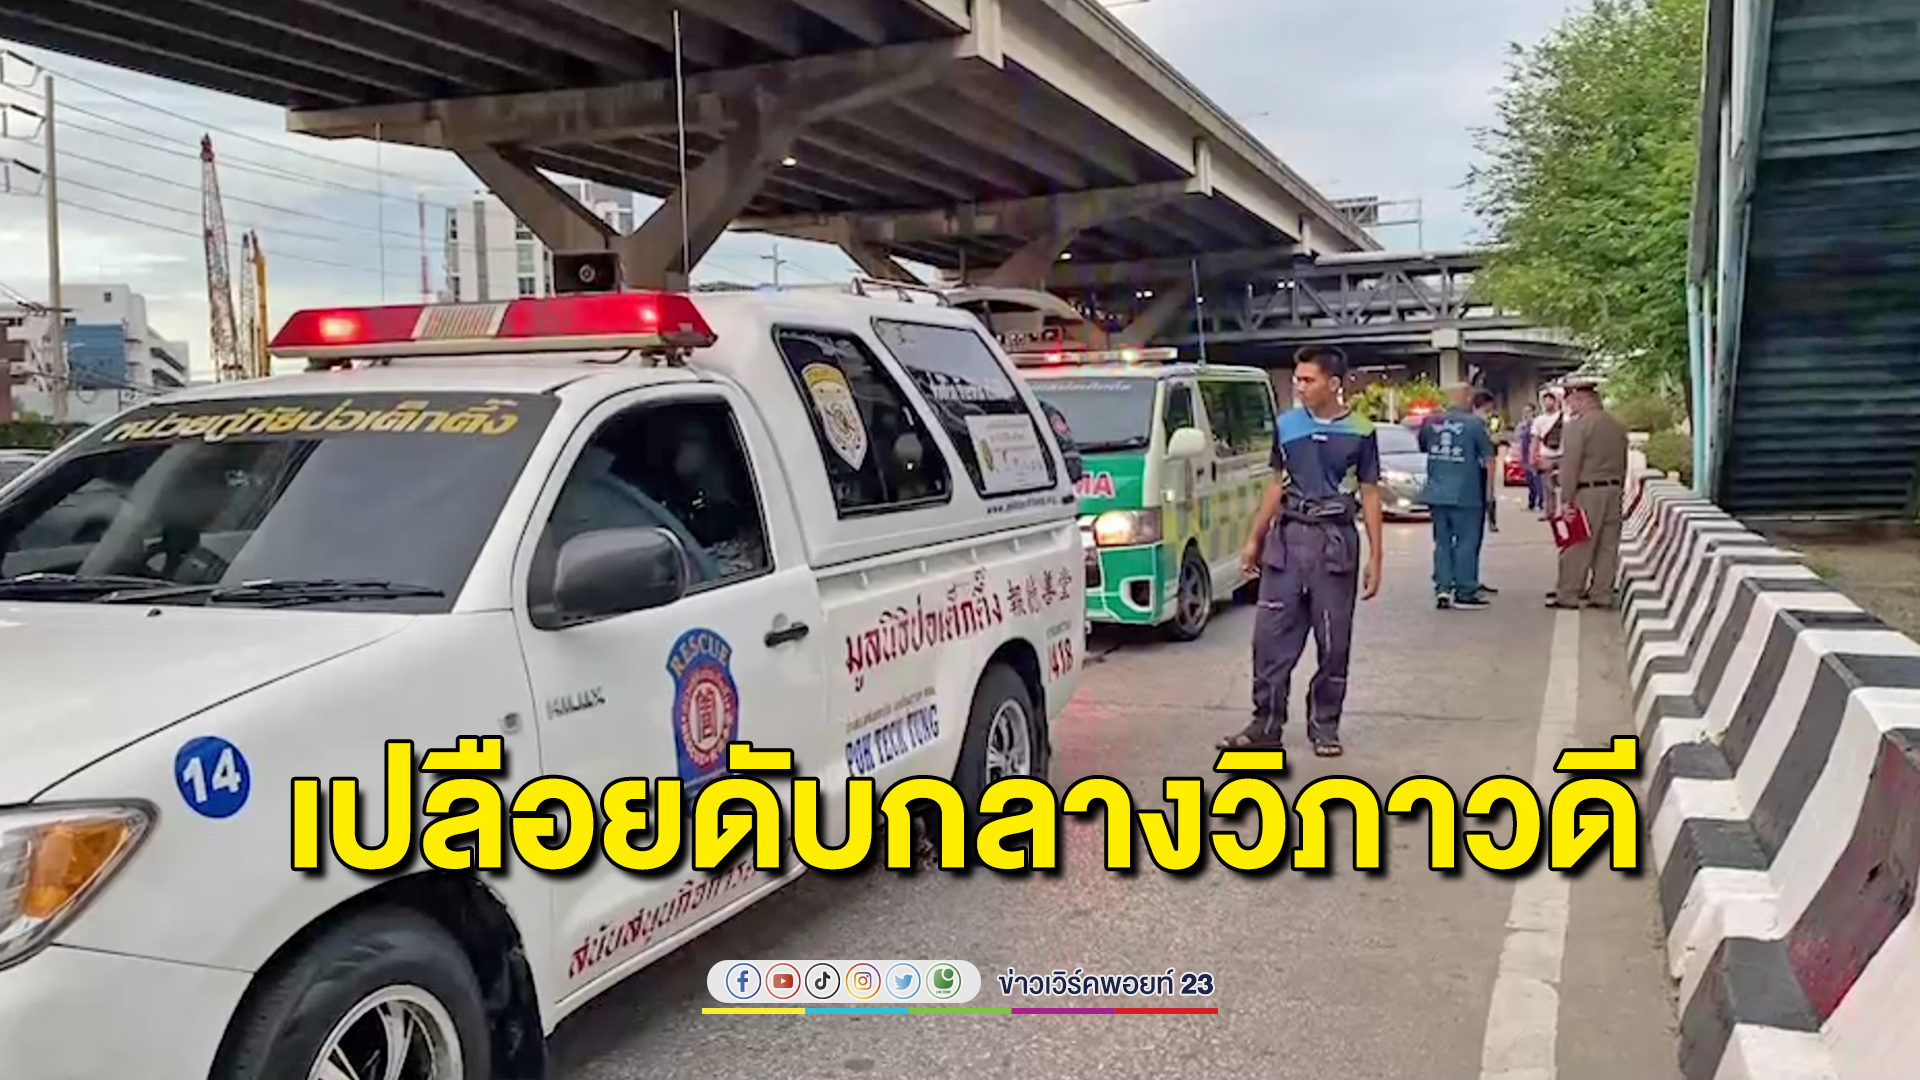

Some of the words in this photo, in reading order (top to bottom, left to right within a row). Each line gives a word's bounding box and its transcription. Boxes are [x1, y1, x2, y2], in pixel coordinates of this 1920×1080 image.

[670, 633, 732, 677] RESCUE
[846, 732, 876, 779] POH
[907, 703, 939, 750] TUNG
[182, 746, 242, 805] 14
